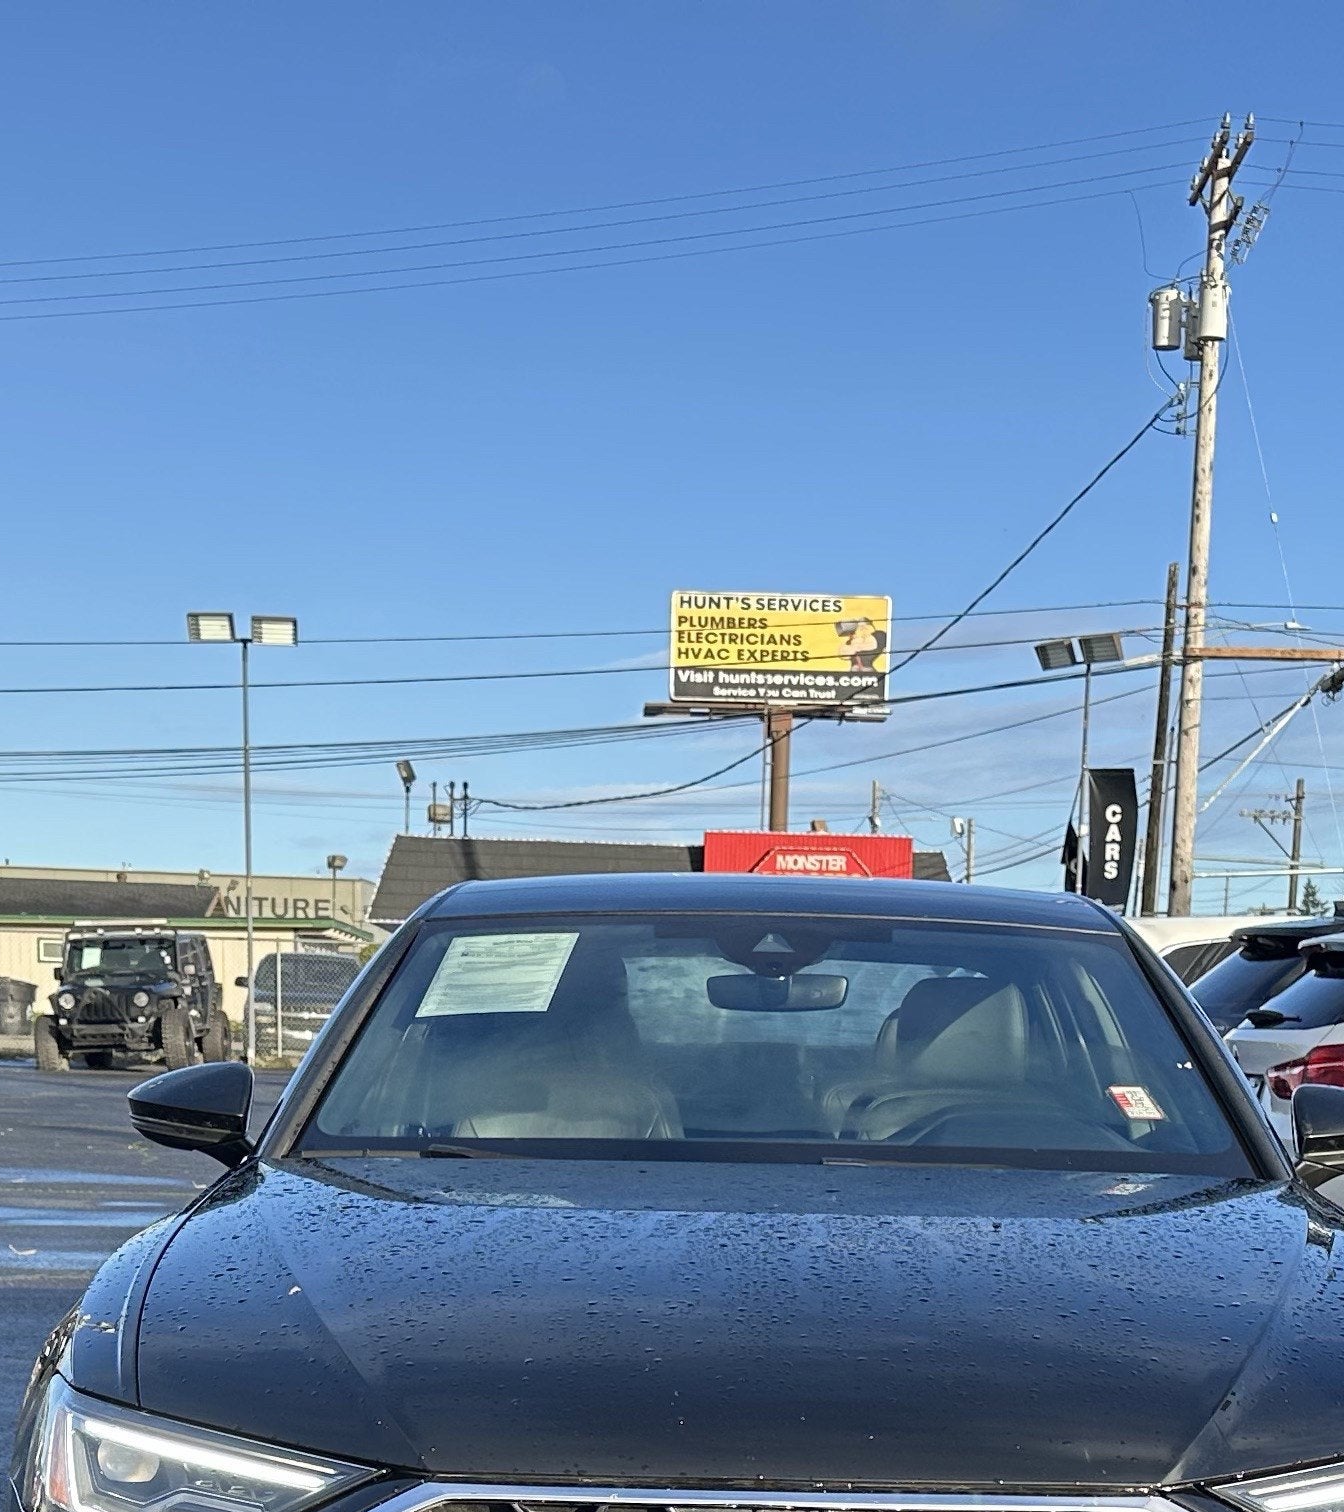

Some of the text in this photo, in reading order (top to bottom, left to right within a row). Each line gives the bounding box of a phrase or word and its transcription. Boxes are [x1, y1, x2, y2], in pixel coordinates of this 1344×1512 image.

[679, 595, 843, 613] HUNT'S SERVICES
[677, 615, 768, 630] PLUMBERS
[677, 630, 802, 647] ELECTRICIANS
[677, 647, 810, 662] HVAC EXPERTS
[677, 670, 715, 684] Visit
[712, 686, 756, 697] Service
[781, 688, 807, 698] Can
[808, 688, 836, 699] Trust
[1104, 803, 1123, 880] CARS
[775, 854, 847, 871] MONSTER
